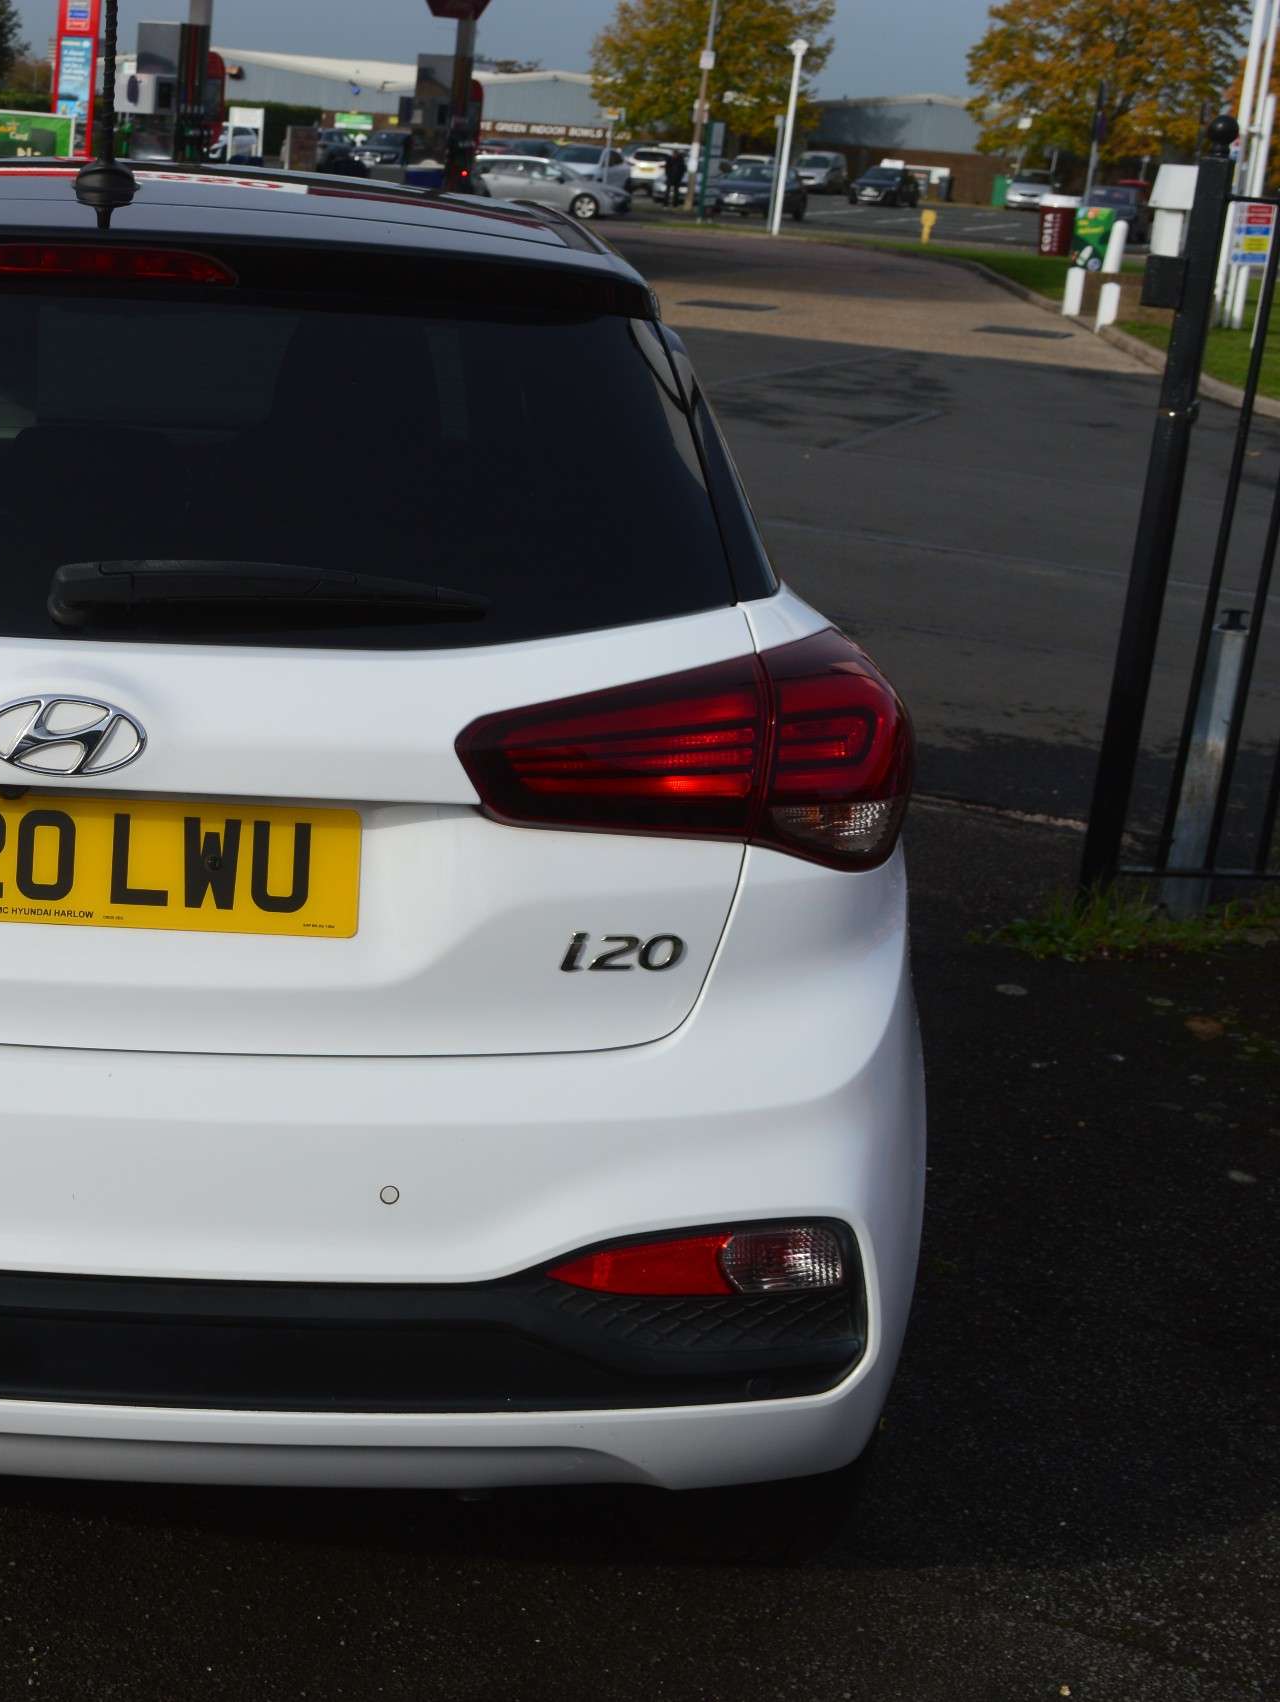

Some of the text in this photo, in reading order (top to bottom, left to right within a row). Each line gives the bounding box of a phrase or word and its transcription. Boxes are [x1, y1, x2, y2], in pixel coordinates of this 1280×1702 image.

[1040, 213, 1054, 252] COSTA
[110, 812, 313, 914] LWU
[11, 906, 52, 917] HYUNDAI
[53, 909, 95, 919] HARLOW
[559, 931, 688, 972] i20
